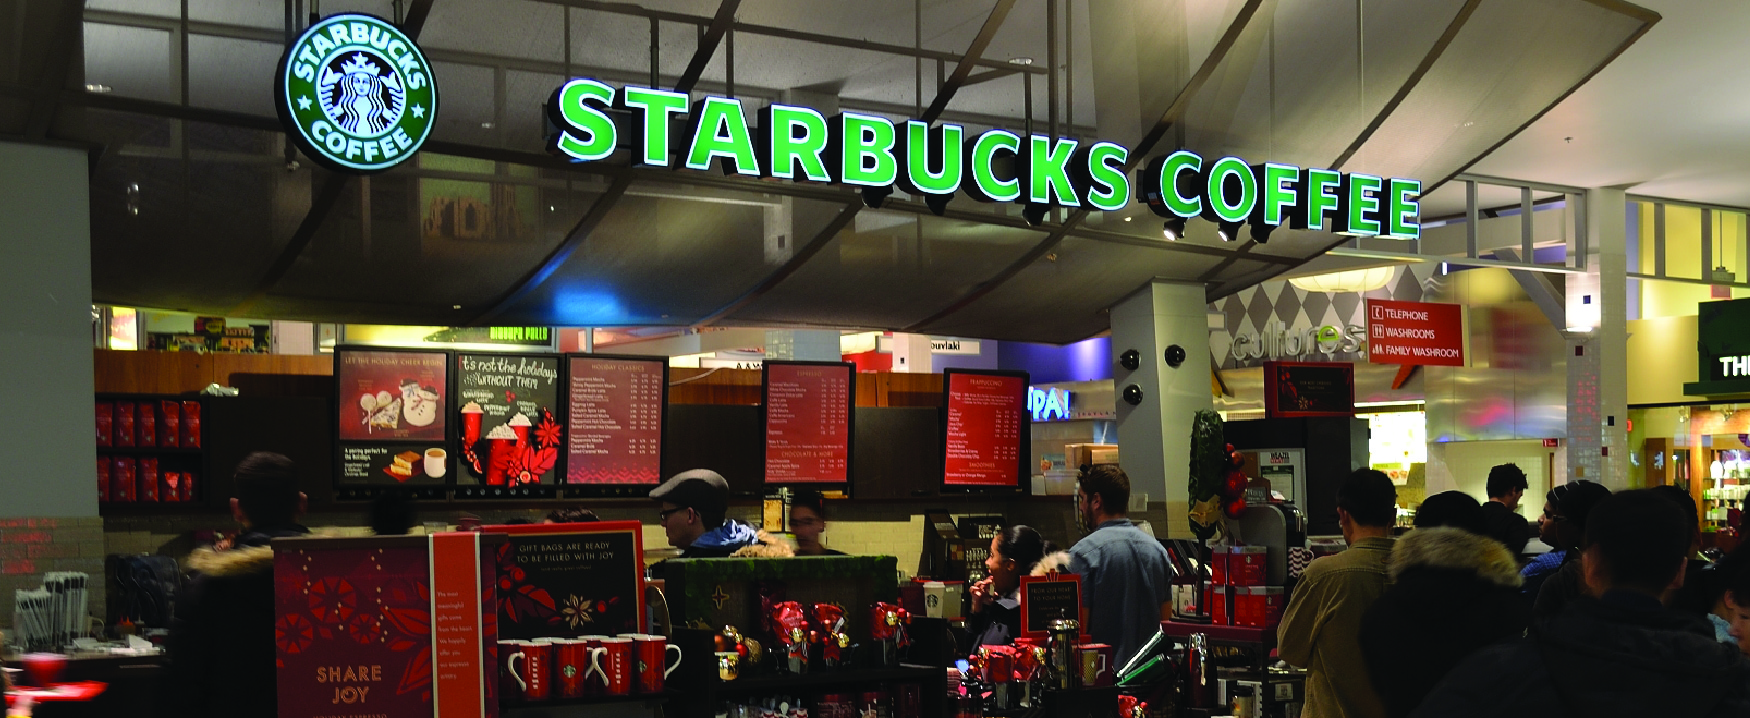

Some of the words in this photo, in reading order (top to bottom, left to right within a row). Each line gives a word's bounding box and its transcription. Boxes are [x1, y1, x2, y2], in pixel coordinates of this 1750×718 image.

[294, 22, 427, 90] STARBUCKS
[311, 120, 413, 162] COFFEE
[555, 77, 1130, 211] STARBUCKS
[1158, 149, 1422, 240] COFFEE
[1385, 308, 1429, 321] TELEPHONE
[1231, 320, 1367, 361] cultures
[1385, 327, 1435, 340] WASHROOMS
[930, 340, 960, 350] ouvlaki
[1386, 344, 1411, 356] FAMILY
[1412, 346, 1459, 358] WASHROOM
[478, 357, 497, 373] not
[497, 357, 517, 374] the
[517, 357, 558, 385] holidays
[1718, 354, 1750, 378] TH
[519, 544, 538, 553] GIFT
[541, 543, 564, 552] BAGS
[566, 542, 582, 551] ARE
[585, 540, 610, 550] READY
[517, 555, 529, 564] TO
[531, 554, 542, 563] BE
[544, 553, 571, 562] FILLED
[574, 552, 595, 561] WITH
[599, 551, 615, 560] JOY
[316, 665, 382, 684] SHARE
[332, 685, 370, 705] JOY
